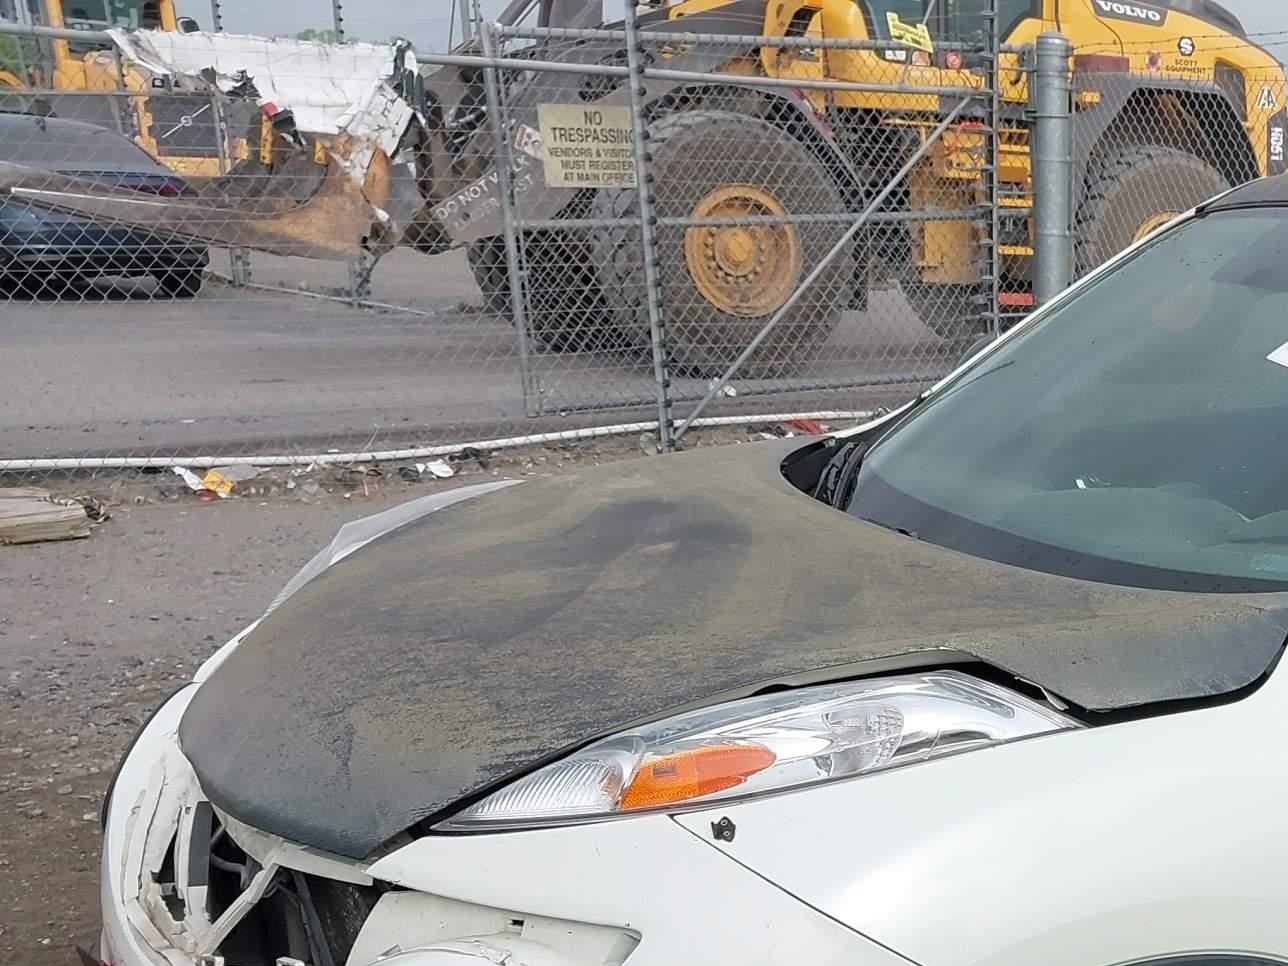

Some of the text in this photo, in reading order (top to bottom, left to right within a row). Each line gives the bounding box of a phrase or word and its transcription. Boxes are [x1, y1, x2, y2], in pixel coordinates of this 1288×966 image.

[1096, 0, 1161, 21] VOLVO
[1175, 59, 1198, 67] SCOTT
[1165, 65, 1206, 75] EQUIPMENT
[584, 111, 602, 126] NO
[548, 147, 593, 158] VENDORS
[561, 160, 634, 171] MUST REGISTER
[563, 172, 635, 183] AT MAIN OFFICE
[435, 201, 458, 220] DO
[458, 180, 488, 206] NOT
